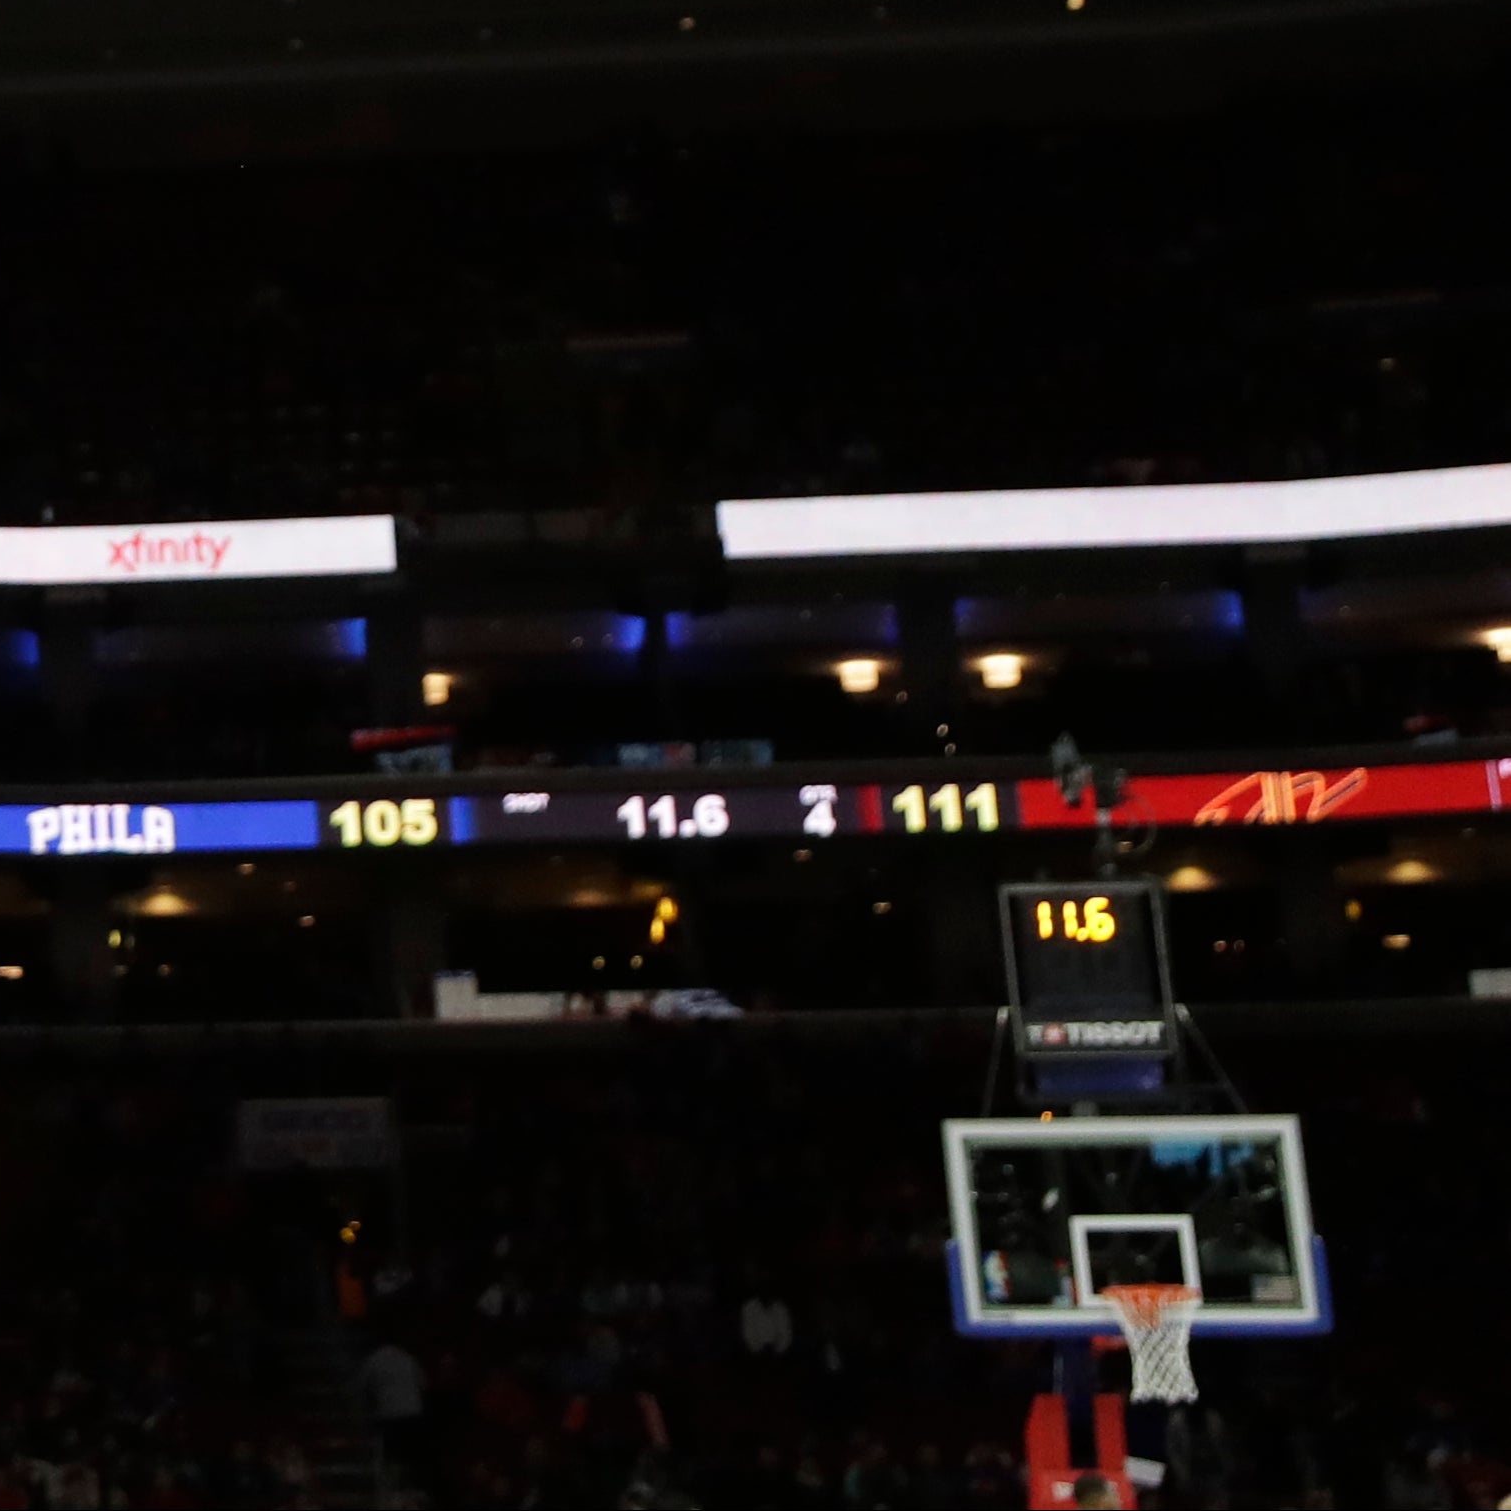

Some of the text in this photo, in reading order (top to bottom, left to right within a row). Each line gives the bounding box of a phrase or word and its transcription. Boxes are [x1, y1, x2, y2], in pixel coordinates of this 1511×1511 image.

[109, 529, 233, 573] xfinity
[26, 803, 177, 856] PHILA
[329, 798, 439, 847] 105
[616, 793, 731, 840] 11.6
[802, 799, 838, 838] 4
[891, 782, 1000, 835] 111
[1036, 896, 1116, 943] 11.6
[1064, 1019, 1166, 1048] TISSOT
